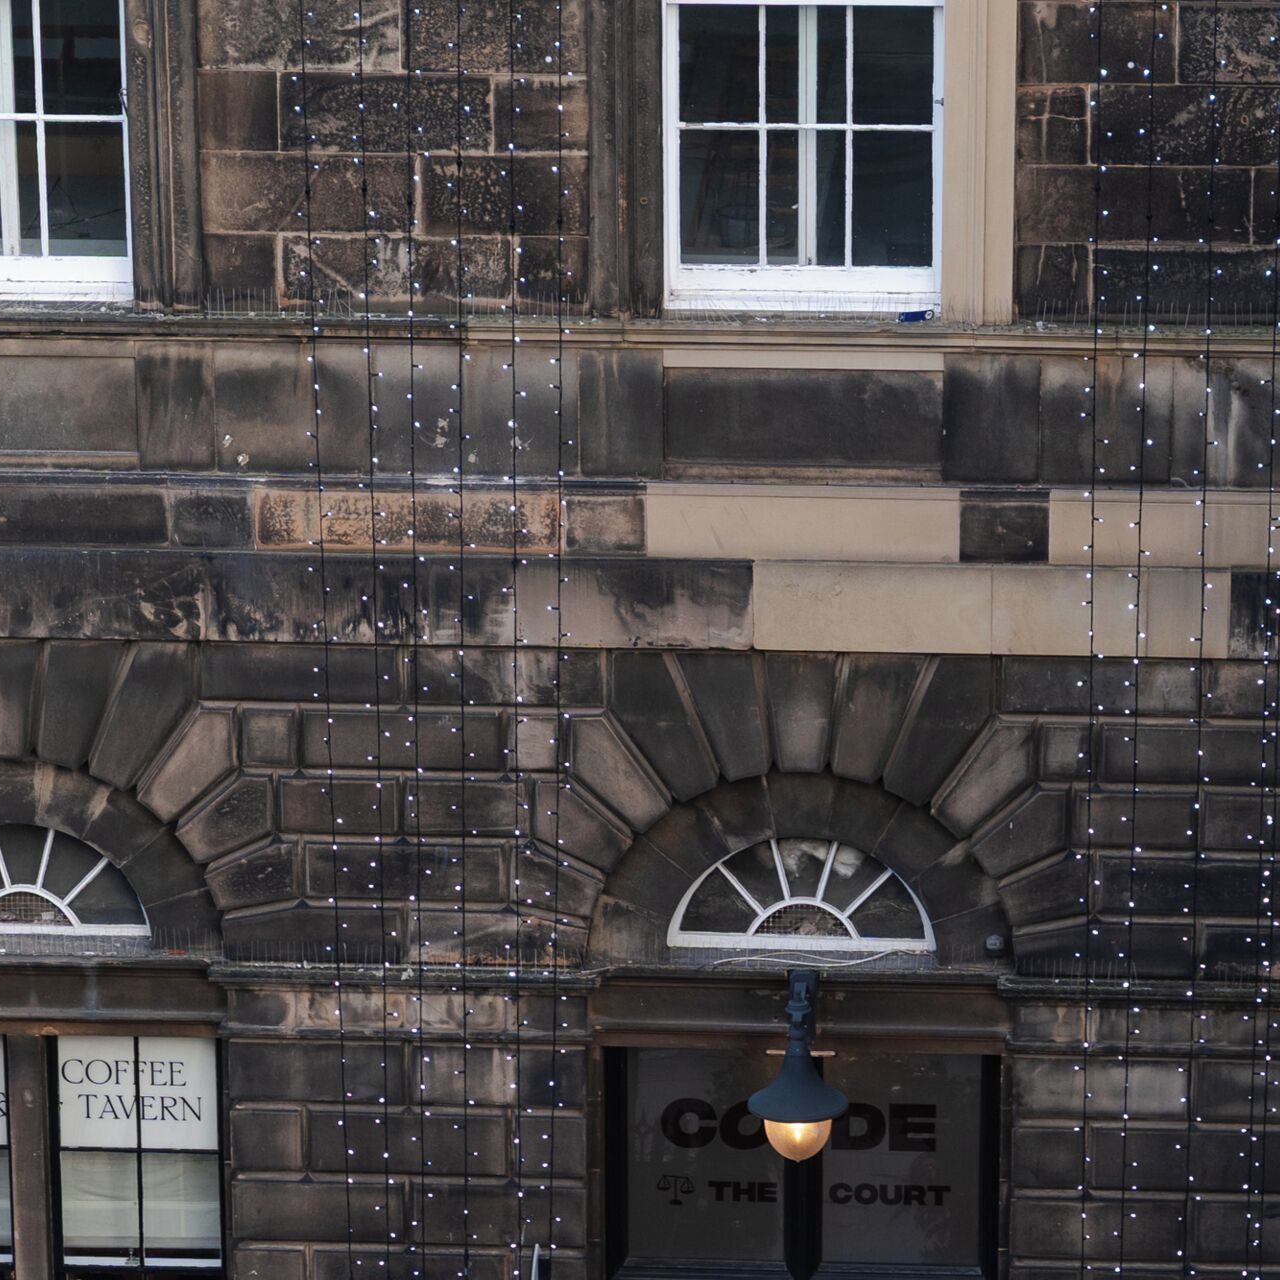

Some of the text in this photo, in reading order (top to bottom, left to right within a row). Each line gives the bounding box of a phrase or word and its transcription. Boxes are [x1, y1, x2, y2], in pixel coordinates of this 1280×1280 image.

[61, 1058, 187, 1087] COFFEE
[77, 1094, 202, 1121] TAVERN
[660, 1097, 937, 1153] CODE
[708, 1180, 951, 1206] THE COURT
